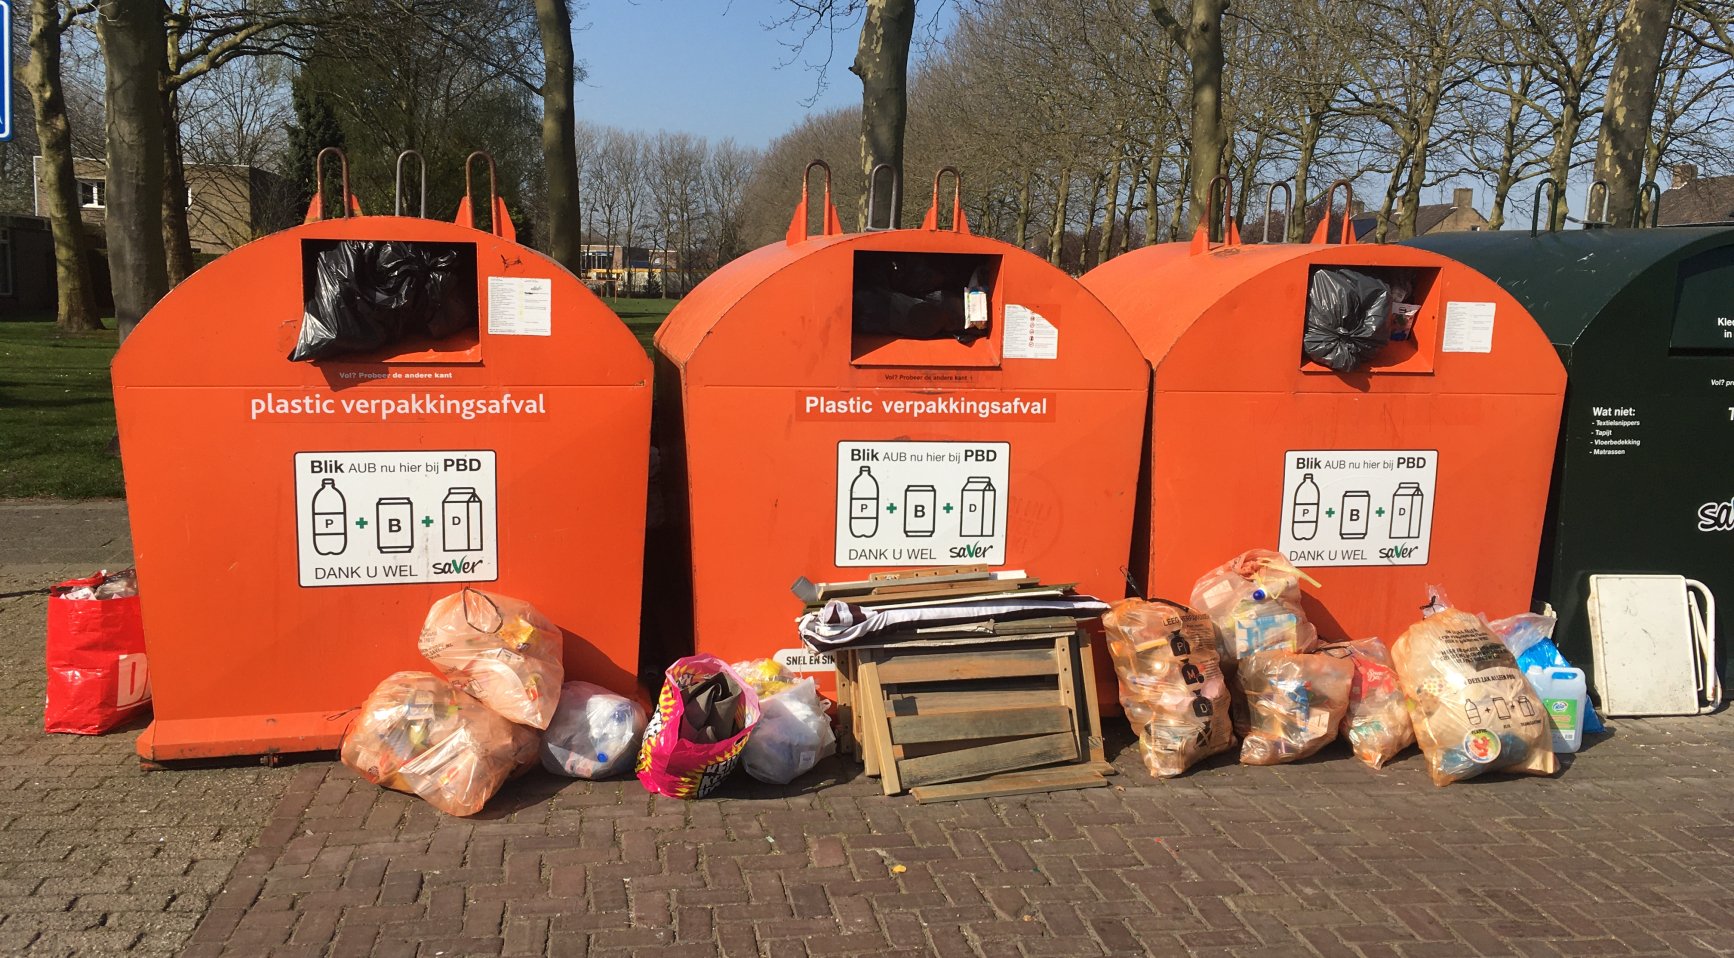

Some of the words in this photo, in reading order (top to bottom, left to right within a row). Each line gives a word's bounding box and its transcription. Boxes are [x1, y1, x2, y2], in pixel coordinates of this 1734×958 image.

[1723, 329, 1733, 338] in
[339, 372, 357, 380] Vol?
[358, 372, 391, 380] Probeer
[392, 372, 403, 380] de
[404, 372, 433, 380] andere
[434, 372, 453, 380] kant
[899, 374, 923, 382] Probeer
[1710, 378, 1725, 387] Vol?
[251, 392, 335, 420] plastic
[340, 392, 546, 421] verpakkingsafval
[805, 394, 874, 415] Plastic
[881, 396, 1047, 419] verpakkingsafval
[1592, 406, 1612, 417] Wat
[1614, 406, 1636, 417] niet:
[1596, 419, 1641, 427] Textielsnippers
[1595, 429, 1613, 437] Tapijt
[1594, 438, 1641, 447] Vloerbedekking
[850, 448, 880, 462] Blik
[882, 451, 907, 462] AUB
[909, 454, 924, 462] nu
[926, 452, 946, 462] hier
[948, 452, 961, 465] bij
[964, 449, 997, 462] PBD
[1593, 448, 1626, 456] Matrassen
[310, 459, 345, 474] Blik
[348, 462, 377, 474] AUB
[380, 464, 396, 473] nu
[399, 462, 422, 473] hier
[425, 461, 439, 475] bij
[443, 458, 482, 472] PBD
[1296, 457, 1322, 470] Blik
[1324, 459, 1346, 470] AUB
[1348, 461, 1361, 470] nu
[1362, 460, 1381, 470] hier
[1382, 459, 1394, 472] bij
[1396, 456, 1427, 469] PBD
[860, 503, 869, 513] P
[913, 504, 926, 519] B
[968, 503, 977, 513] D
[1302, 508, 1310, 518] P
[1349, 508, 1360, 522] B
[1398, 507, 1406, 517] D
[325, 518, 334, 529] P
[388, 518, 402, 533] B
[451, 515, 462, 526] D
[848, 548, 889, 561] DANK
[892, 548, 903, 561] U
[906, 548, 937, 560] WEL
[1288, 550, 1325, 562] DANK
[1328, 549, 1338, 561] U
[1341, 549, 1368, 561] WEL
[314, 566, 362, 580] DANK
[366, 565, 378, 579] U
[382, 564, 419, 578] WEL
[786, 655, 808, 666] SNEL
[809, 655, 821, 665] EN
